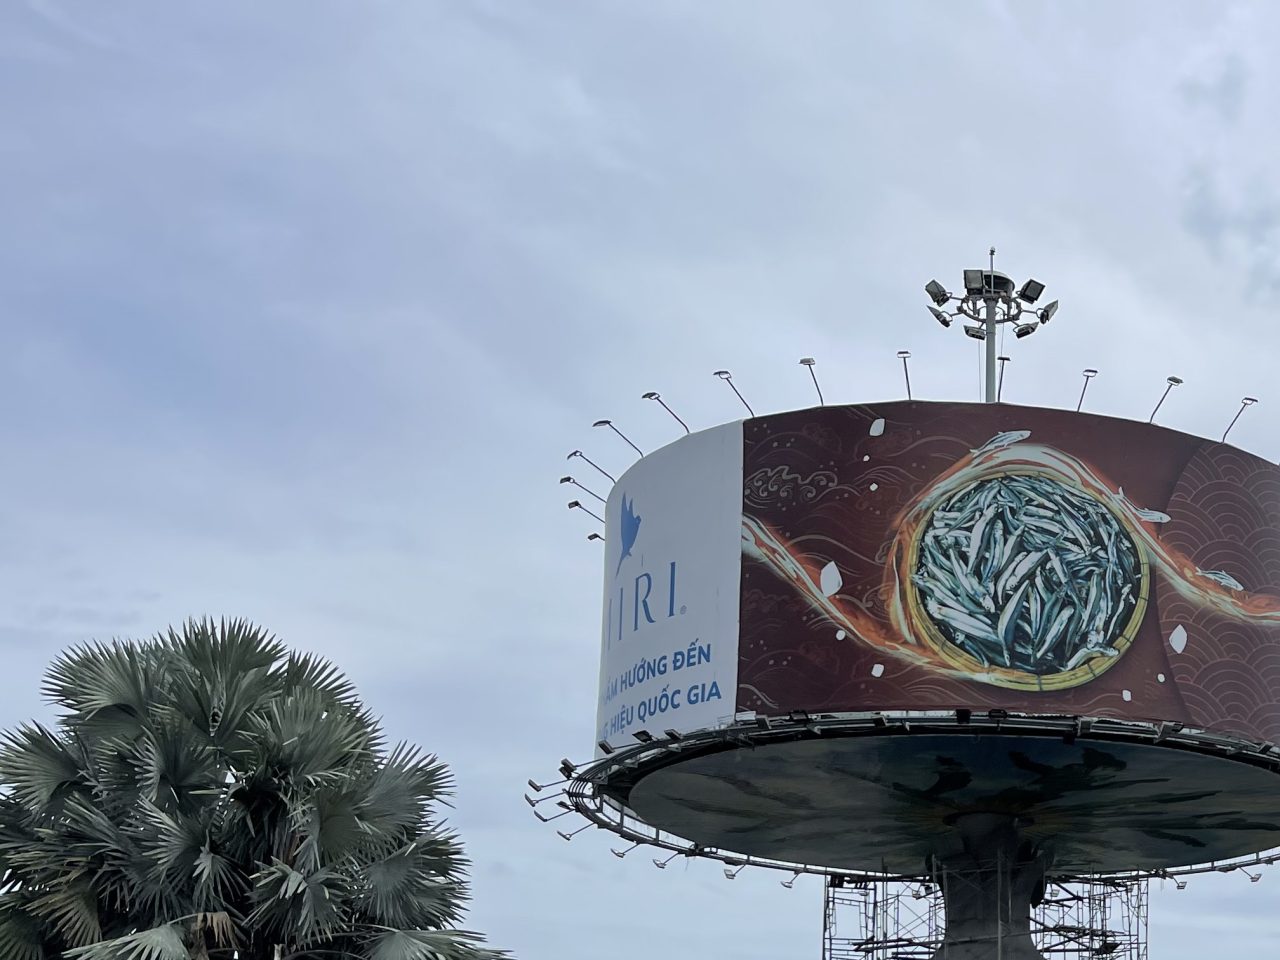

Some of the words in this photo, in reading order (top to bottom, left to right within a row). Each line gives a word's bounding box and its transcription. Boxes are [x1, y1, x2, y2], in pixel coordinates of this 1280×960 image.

[620, 657, 668, 692] HƯỚNG
[672, 637, 711, 671] ĐẾN
[610, 704, 634, 736] HIỆU
[637, 683, 682, 724] QUỐC
[687, 680, 722, 705] GIA
